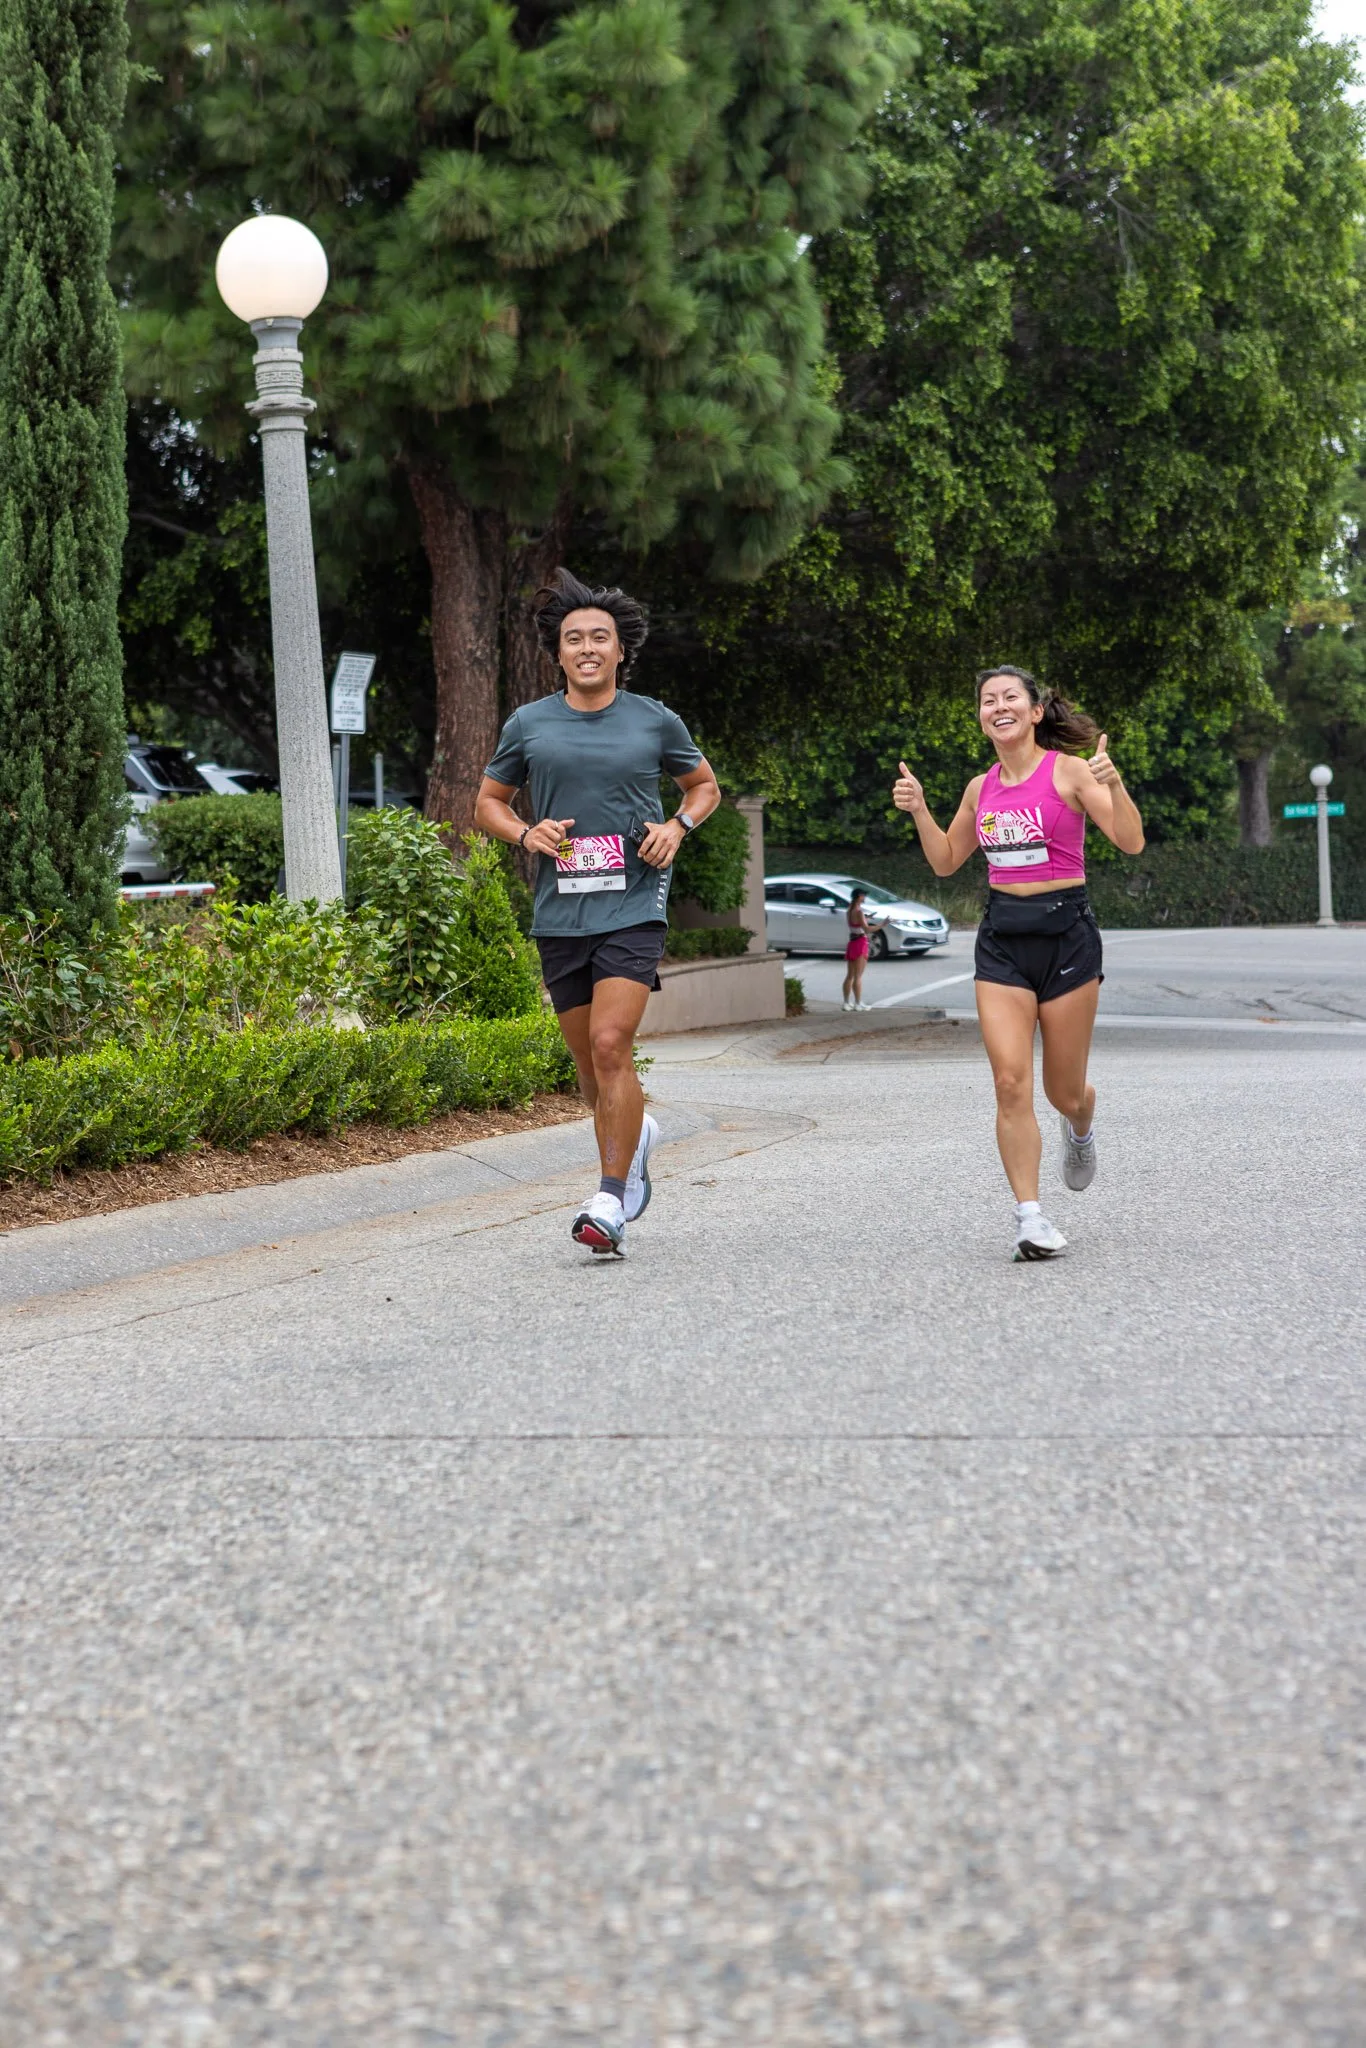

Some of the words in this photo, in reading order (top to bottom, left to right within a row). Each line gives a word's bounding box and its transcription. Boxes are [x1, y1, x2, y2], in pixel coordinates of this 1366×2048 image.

[1003, 828, 1015, 841] 91
[583, 855, 595, 867] 95
[656, 874, 668, 910] GYMSH
